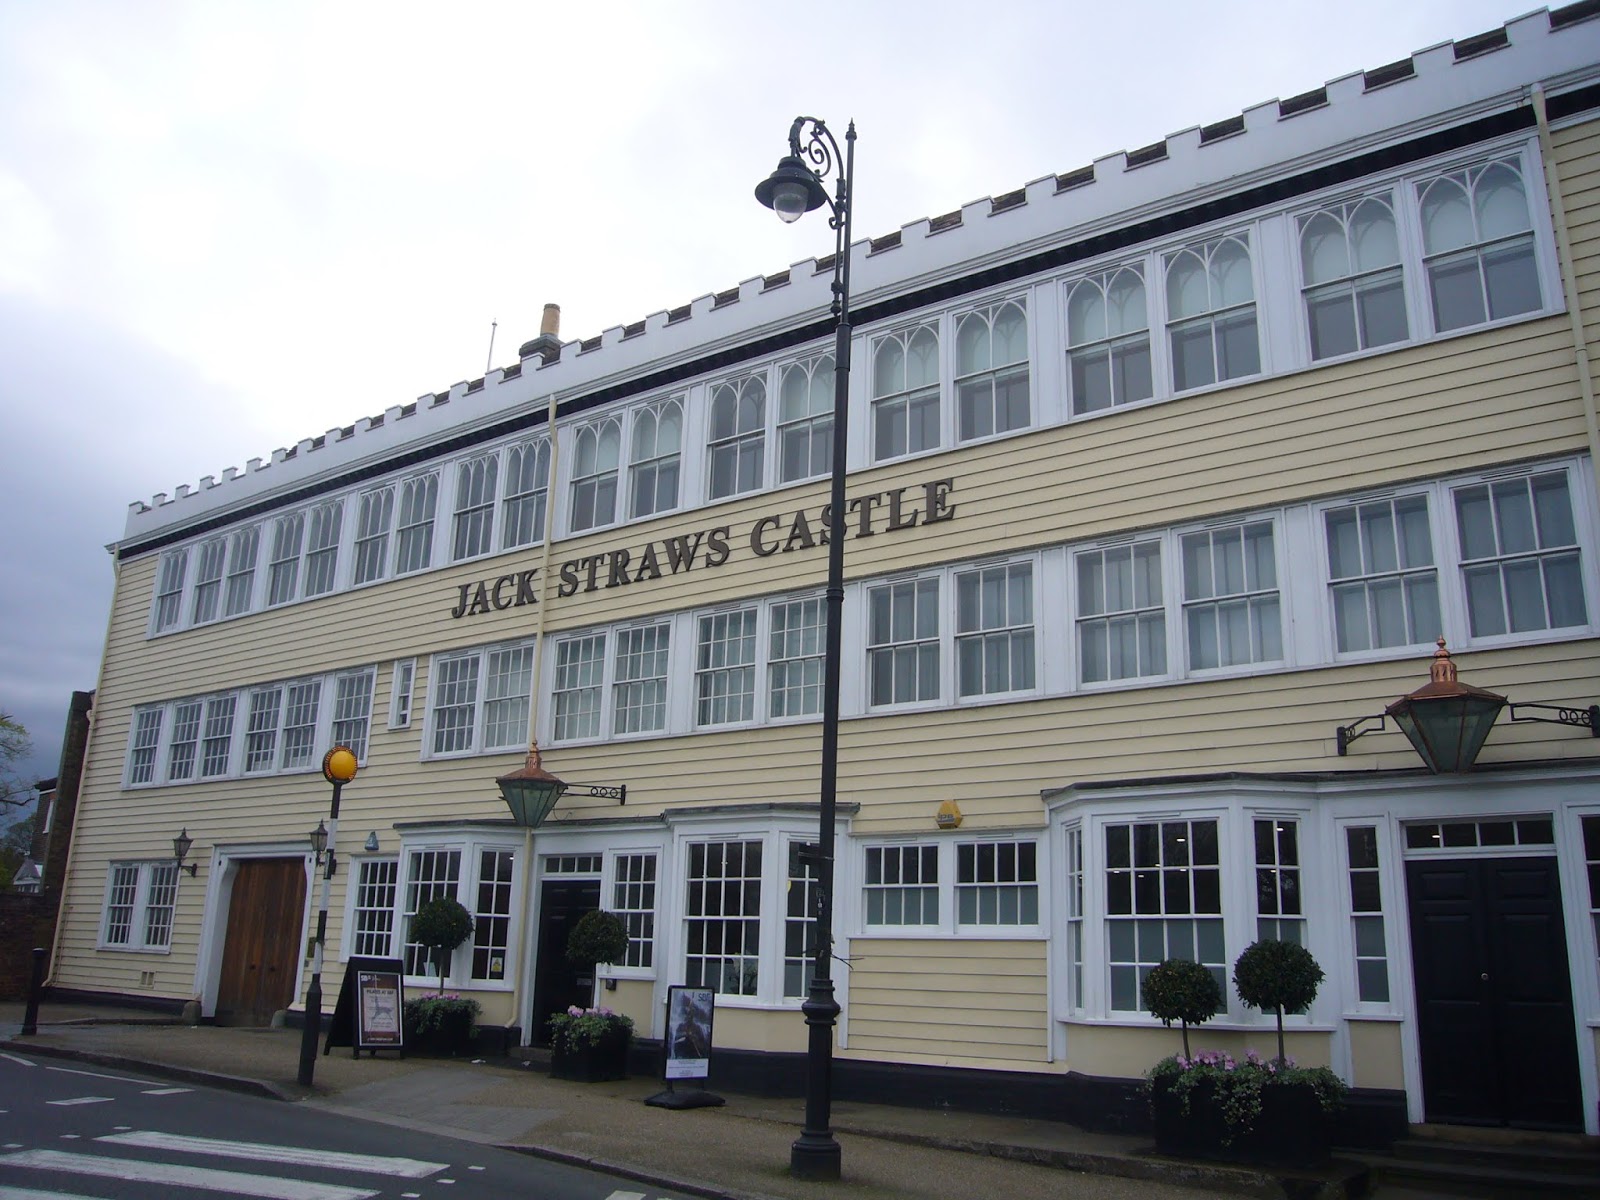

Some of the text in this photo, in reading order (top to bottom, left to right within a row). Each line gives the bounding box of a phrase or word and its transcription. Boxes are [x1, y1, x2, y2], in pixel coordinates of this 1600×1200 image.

[451, 478, 957, 619] JACK STRAWS CASTLE
